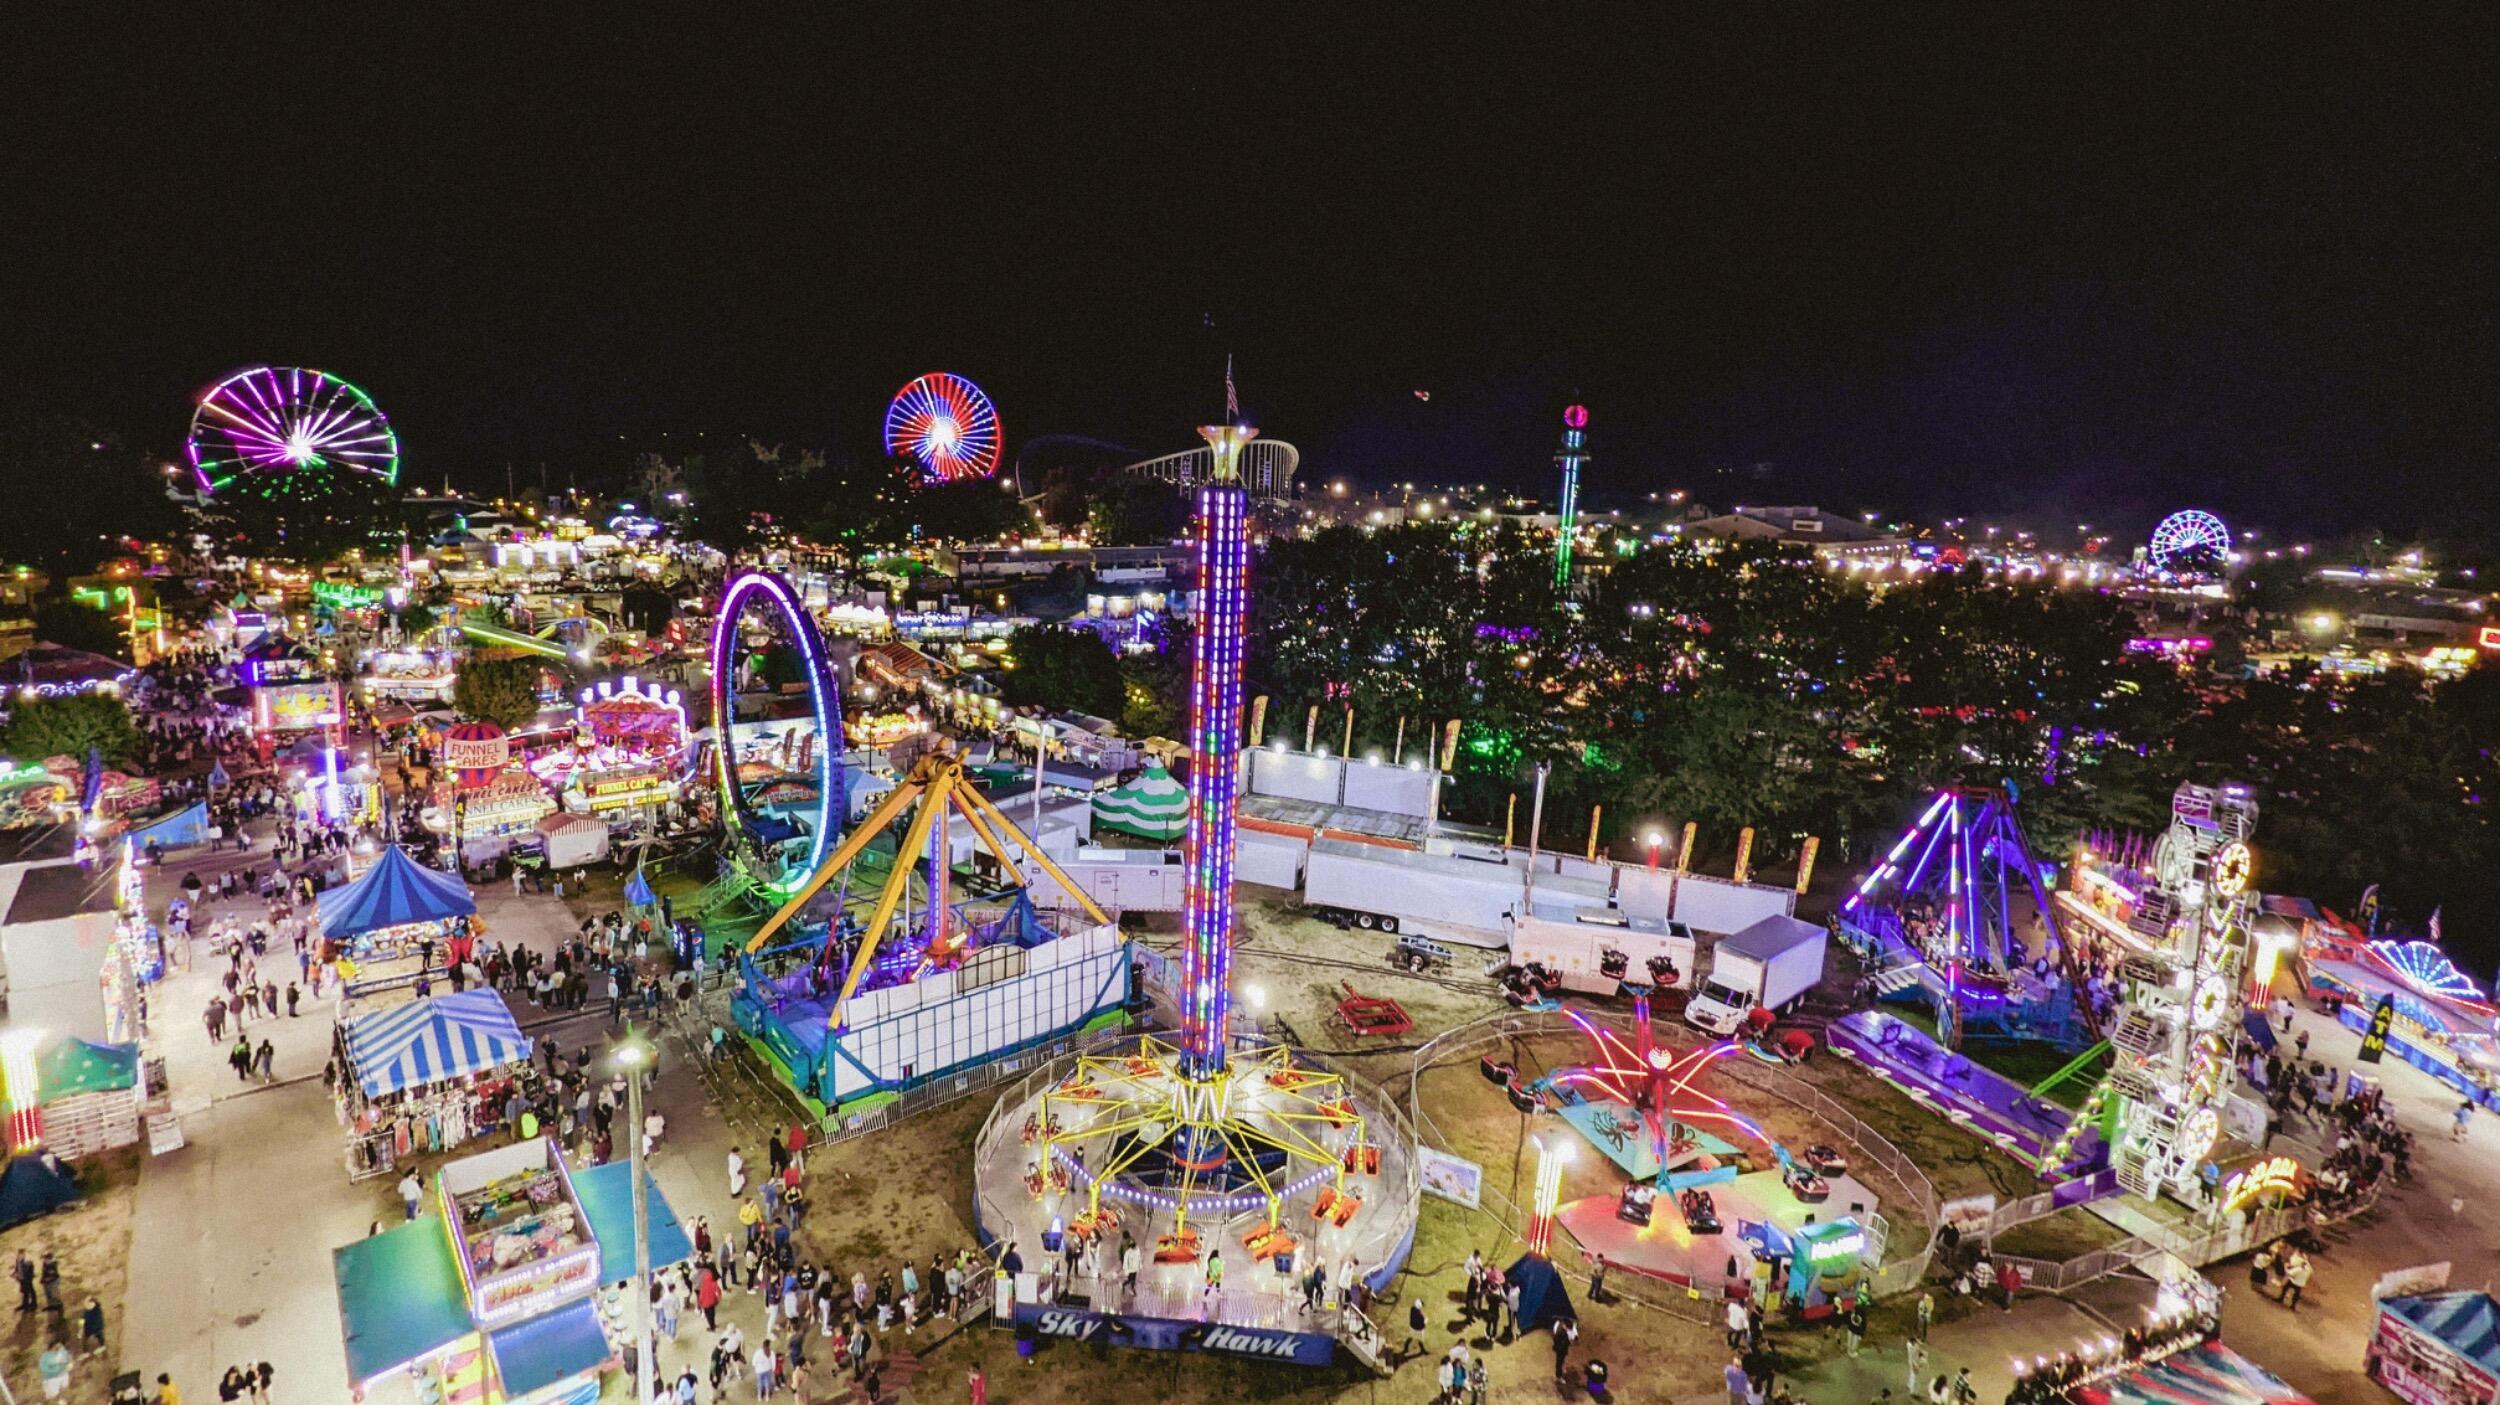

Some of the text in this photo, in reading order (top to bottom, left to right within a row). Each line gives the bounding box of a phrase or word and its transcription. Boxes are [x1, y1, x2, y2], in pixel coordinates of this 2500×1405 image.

[452, 743, 501, 756] FUNNEL
[2365, 1005, 2391, 1051] ATM
[1038, 1311, 1301, 1357] Sky Hawk
